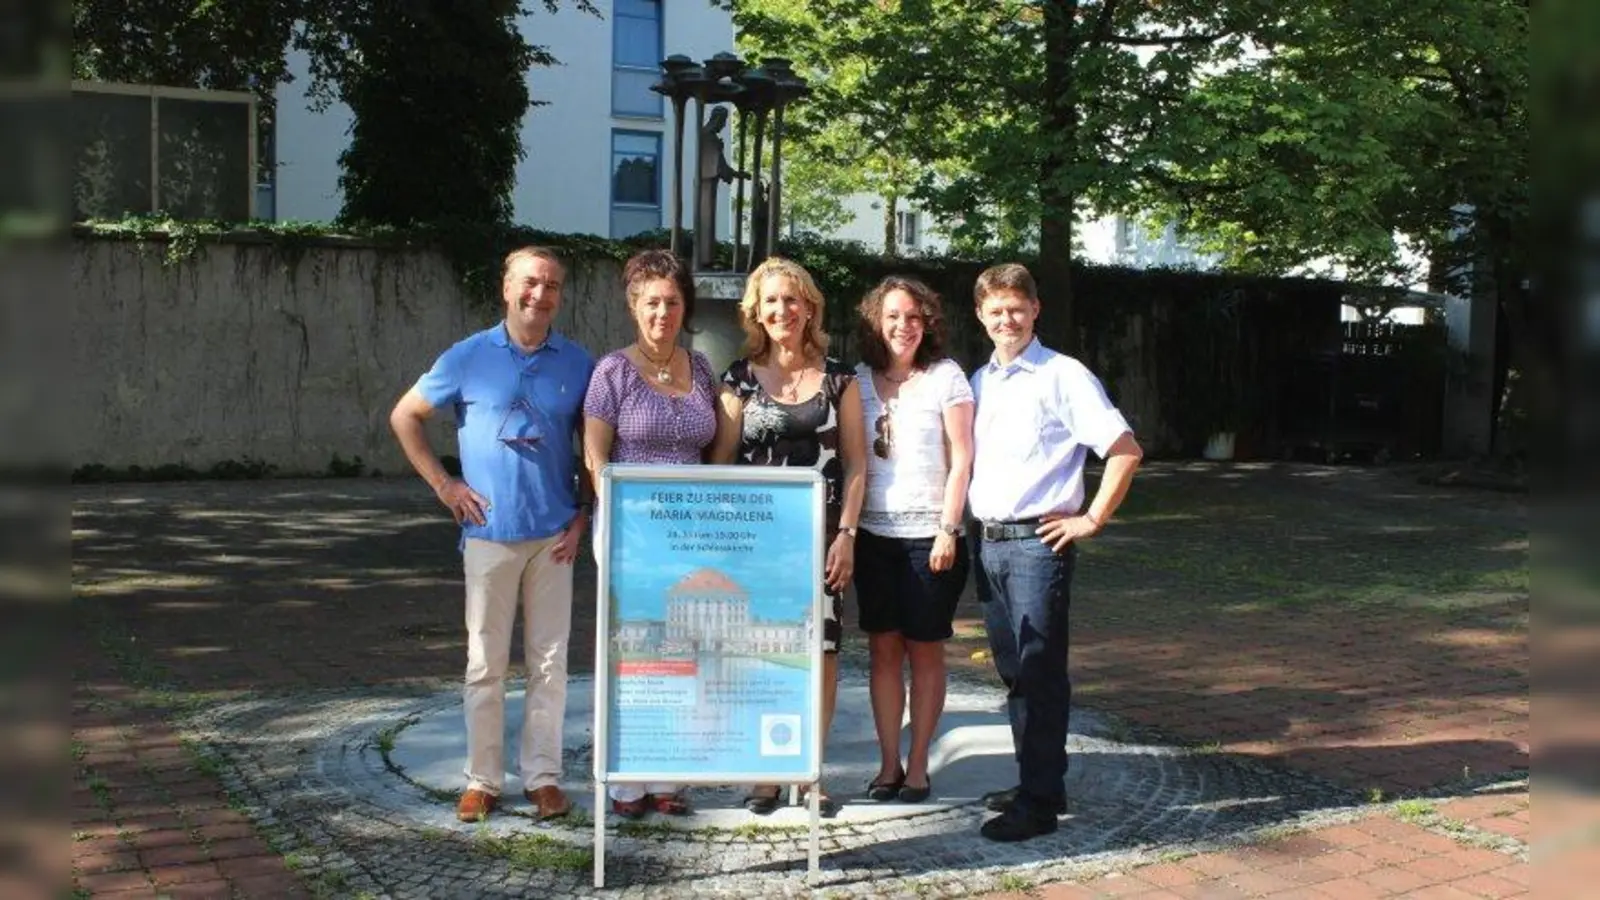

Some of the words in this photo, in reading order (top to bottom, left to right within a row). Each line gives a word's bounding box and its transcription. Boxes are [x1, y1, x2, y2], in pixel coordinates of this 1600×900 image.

[650, 492, 683, 504] FEIER
[686, 492, 704, 504] ZU
[706, 492, 747, 505] EHREN
[749, 493, 775, 505] DER
[650, 509, 692, 521] MARIA
[697, 510, 774, 522] MAGDALENA
[680, 542, 696, 551] der
